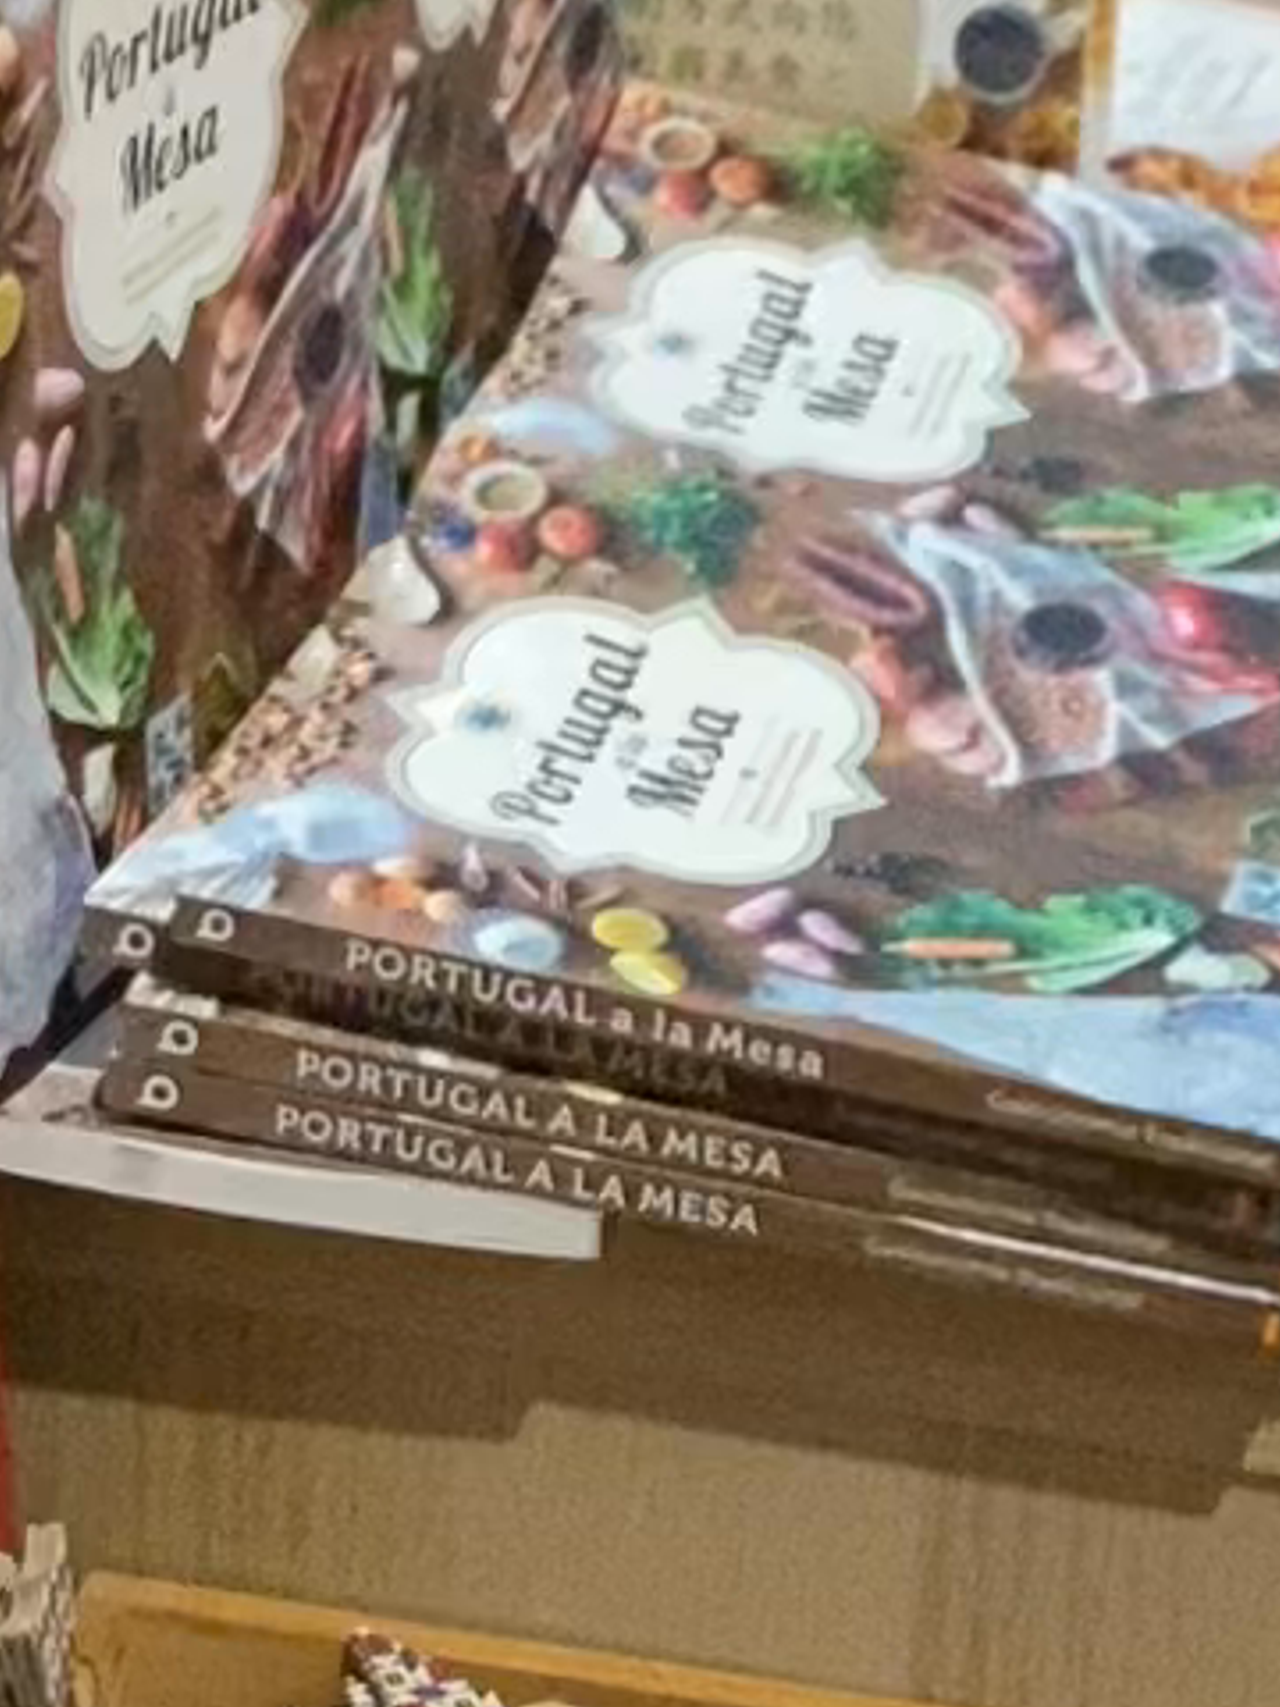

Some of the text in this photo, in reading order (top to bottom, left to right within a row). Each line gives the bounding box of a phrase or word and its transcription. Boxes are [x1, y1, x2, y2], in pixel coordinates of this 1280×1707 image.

[119, 105, 220, 214] Mesa
[681, 267, 814, 437] Portugal
[801, 331, 901, 428] Mesa
[489, 633, 649, 826] Portugal
[625, 704, 741, 817] Mesa
[344, 938, 598, 1027] PORTUGAL
[275, 1102, 514, 1185] PORTUGAL
[573, 1166, 628, 1209] LA
[637, 1178, 761, 1237] MESA
[295, 1049, 536, 1131] PORTUGAL
[595, 1113, 648, 1157] LA
[660, 1125, 786, 1182] MESA
